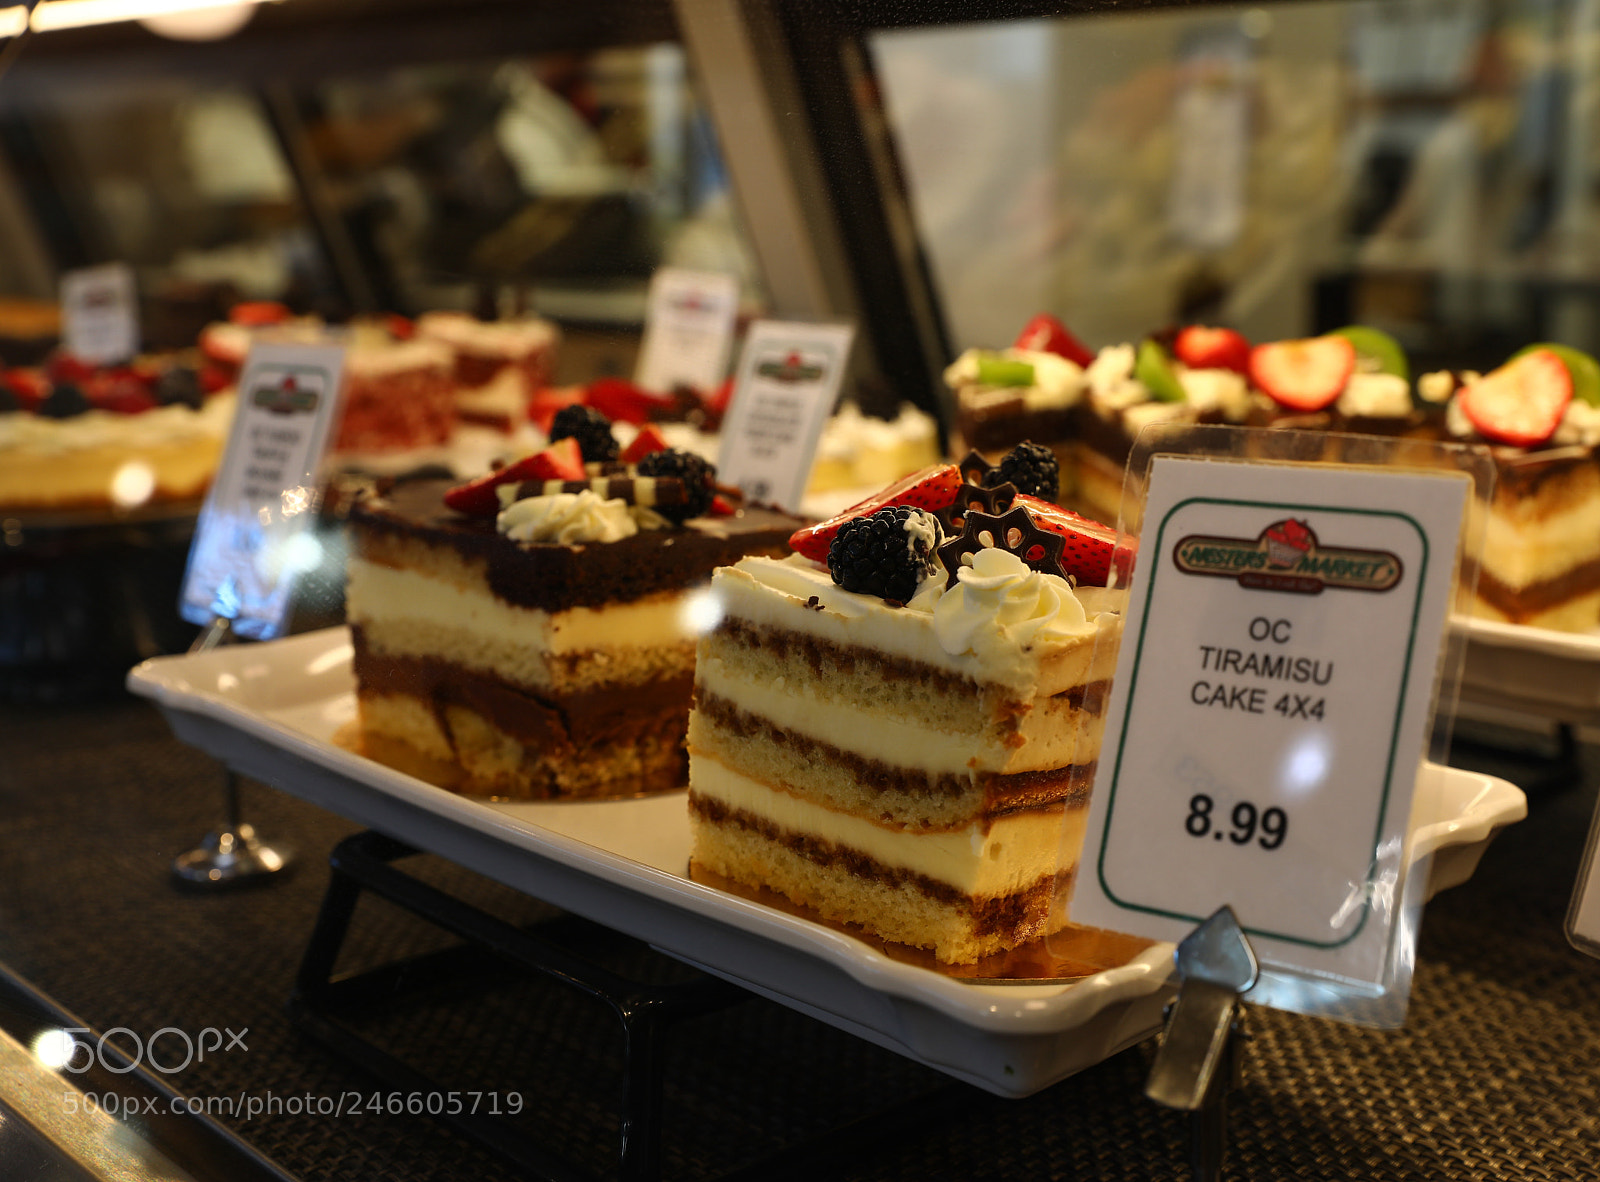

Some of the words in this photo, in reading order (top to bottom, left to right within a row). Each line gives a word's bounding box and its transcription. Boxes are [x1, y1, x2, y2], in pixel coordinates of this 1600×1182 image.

[1187, 546, 1268, 569] NESTERS
[1296, 556, 1387, 578] MARKET
[1248, 616, 1292, 644] OC
[1199, 645, 1334, 686] TIRAMISU
[1191, 680, 1267, 714] CAKE
[1274, 693, 1326, 722] 4X4
[1185, 793, 1288, 851] 8.99
